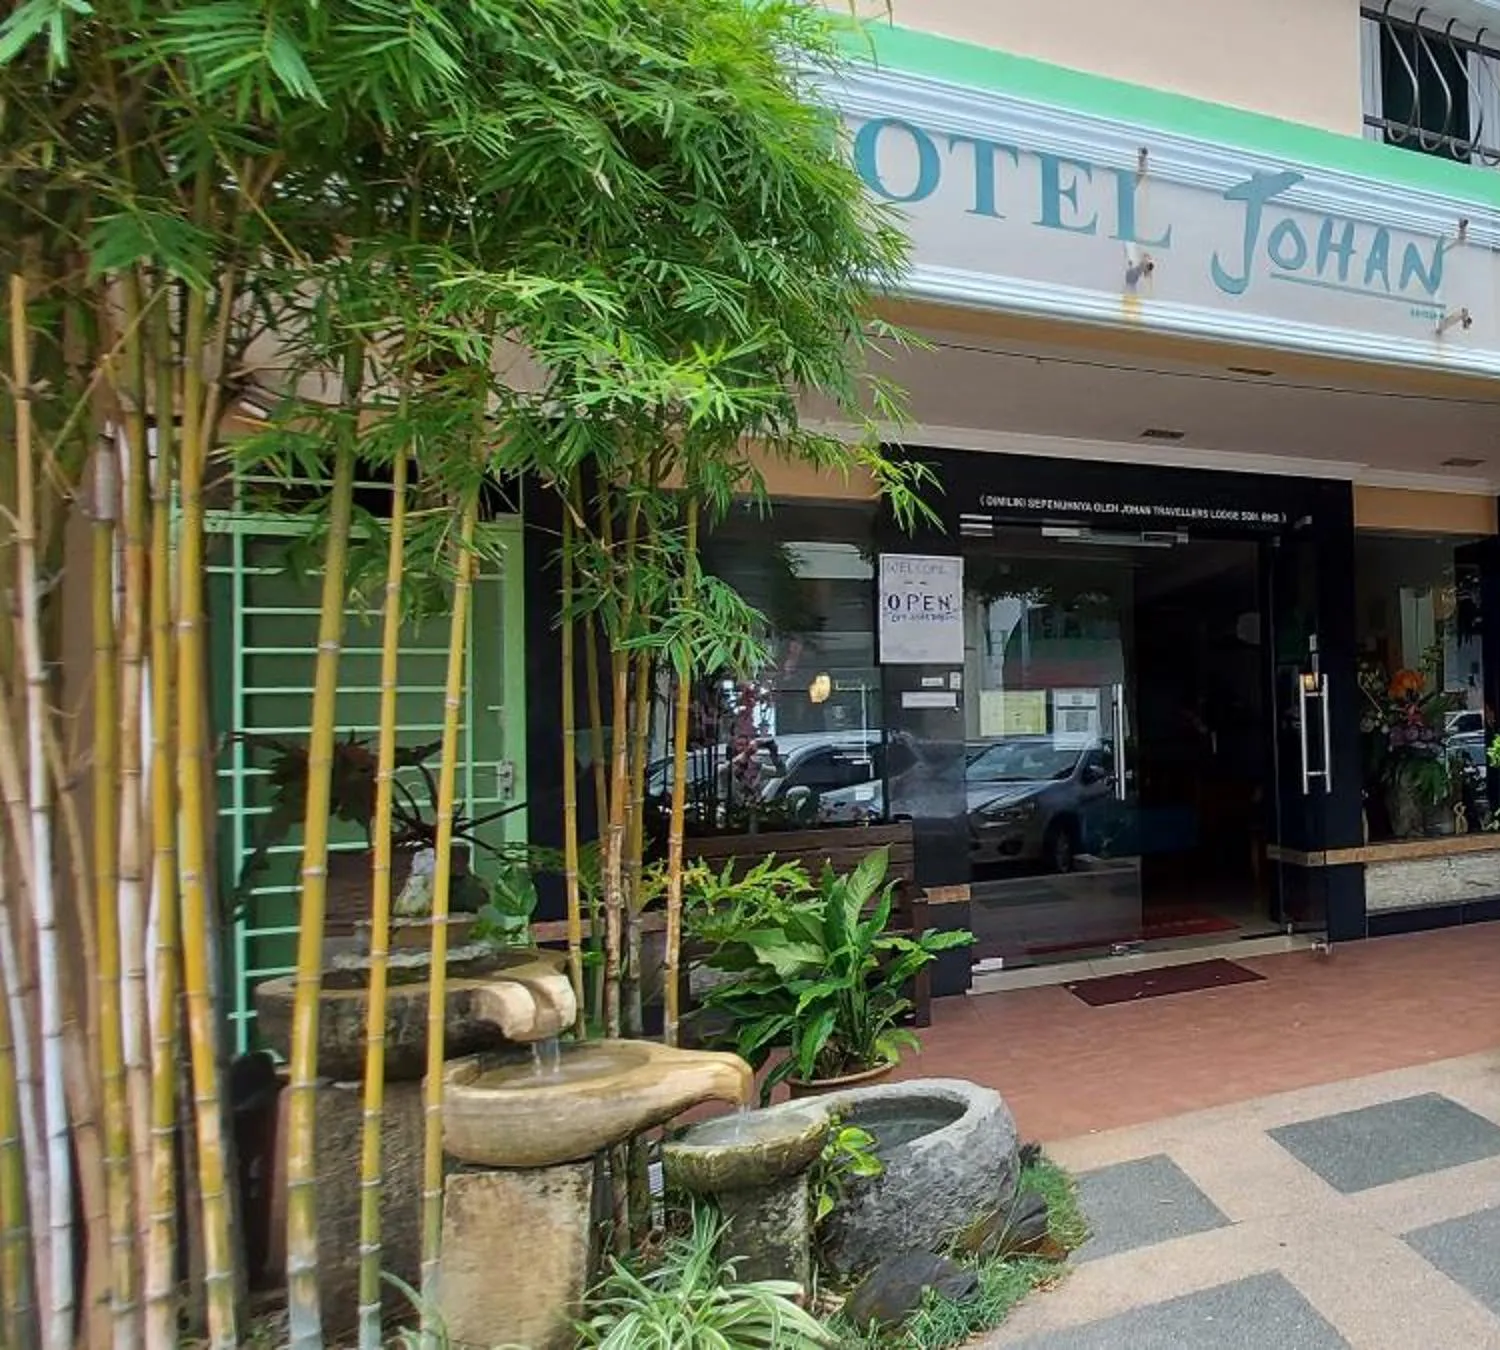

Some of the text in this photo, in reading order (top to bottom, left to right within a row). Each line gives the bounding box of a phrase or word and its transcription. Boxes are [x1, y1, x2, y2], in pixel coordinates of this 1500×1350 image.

[853, 116, 1448, 295] OTEL JOHAN
[1027, 498, 1092, 511] SEPENUHNYA
[1093, 502, 1119, 513] OLEH
[1120, 504, 1151, 515] JOHAN
[1152, 505, 1209, 518] TRAVELLERS
[1210, 509, 1239, 520] LODGE
[887, 592, 952, 612] OPEN
